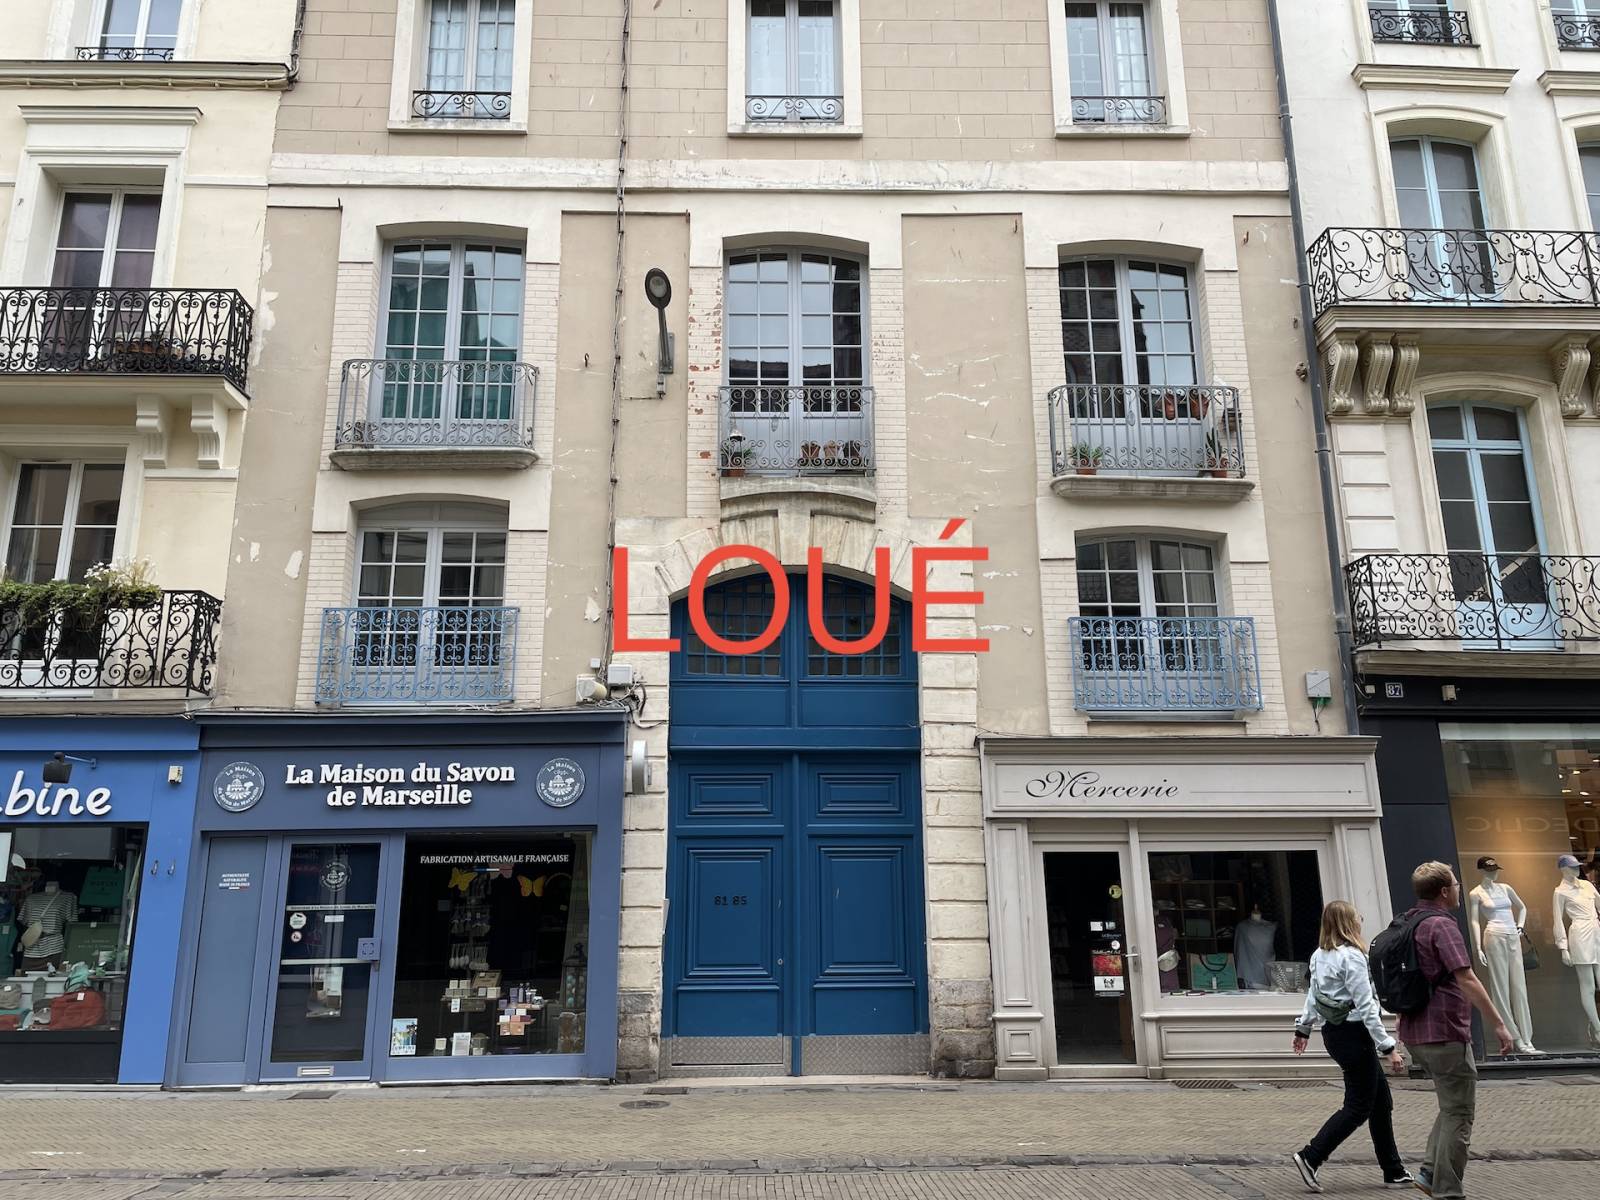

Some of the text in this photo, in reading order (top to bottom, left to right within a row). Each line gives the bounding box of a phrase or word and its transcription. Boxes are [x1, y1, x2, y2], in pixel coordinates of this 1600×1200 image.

[1388, 684, 1401, 696] 87
[285, 762, 515, 784] La Maison du Savon
[1025, 770, 1180, 798] Mercerie
[0, 770, 112, 816] bine
[327, 784, 472, 806] de Marseille
[420, 854, 569, 864] FABRICATION ARTISANALE FRANÇAISE
[714, 895, 728, 906] 81
